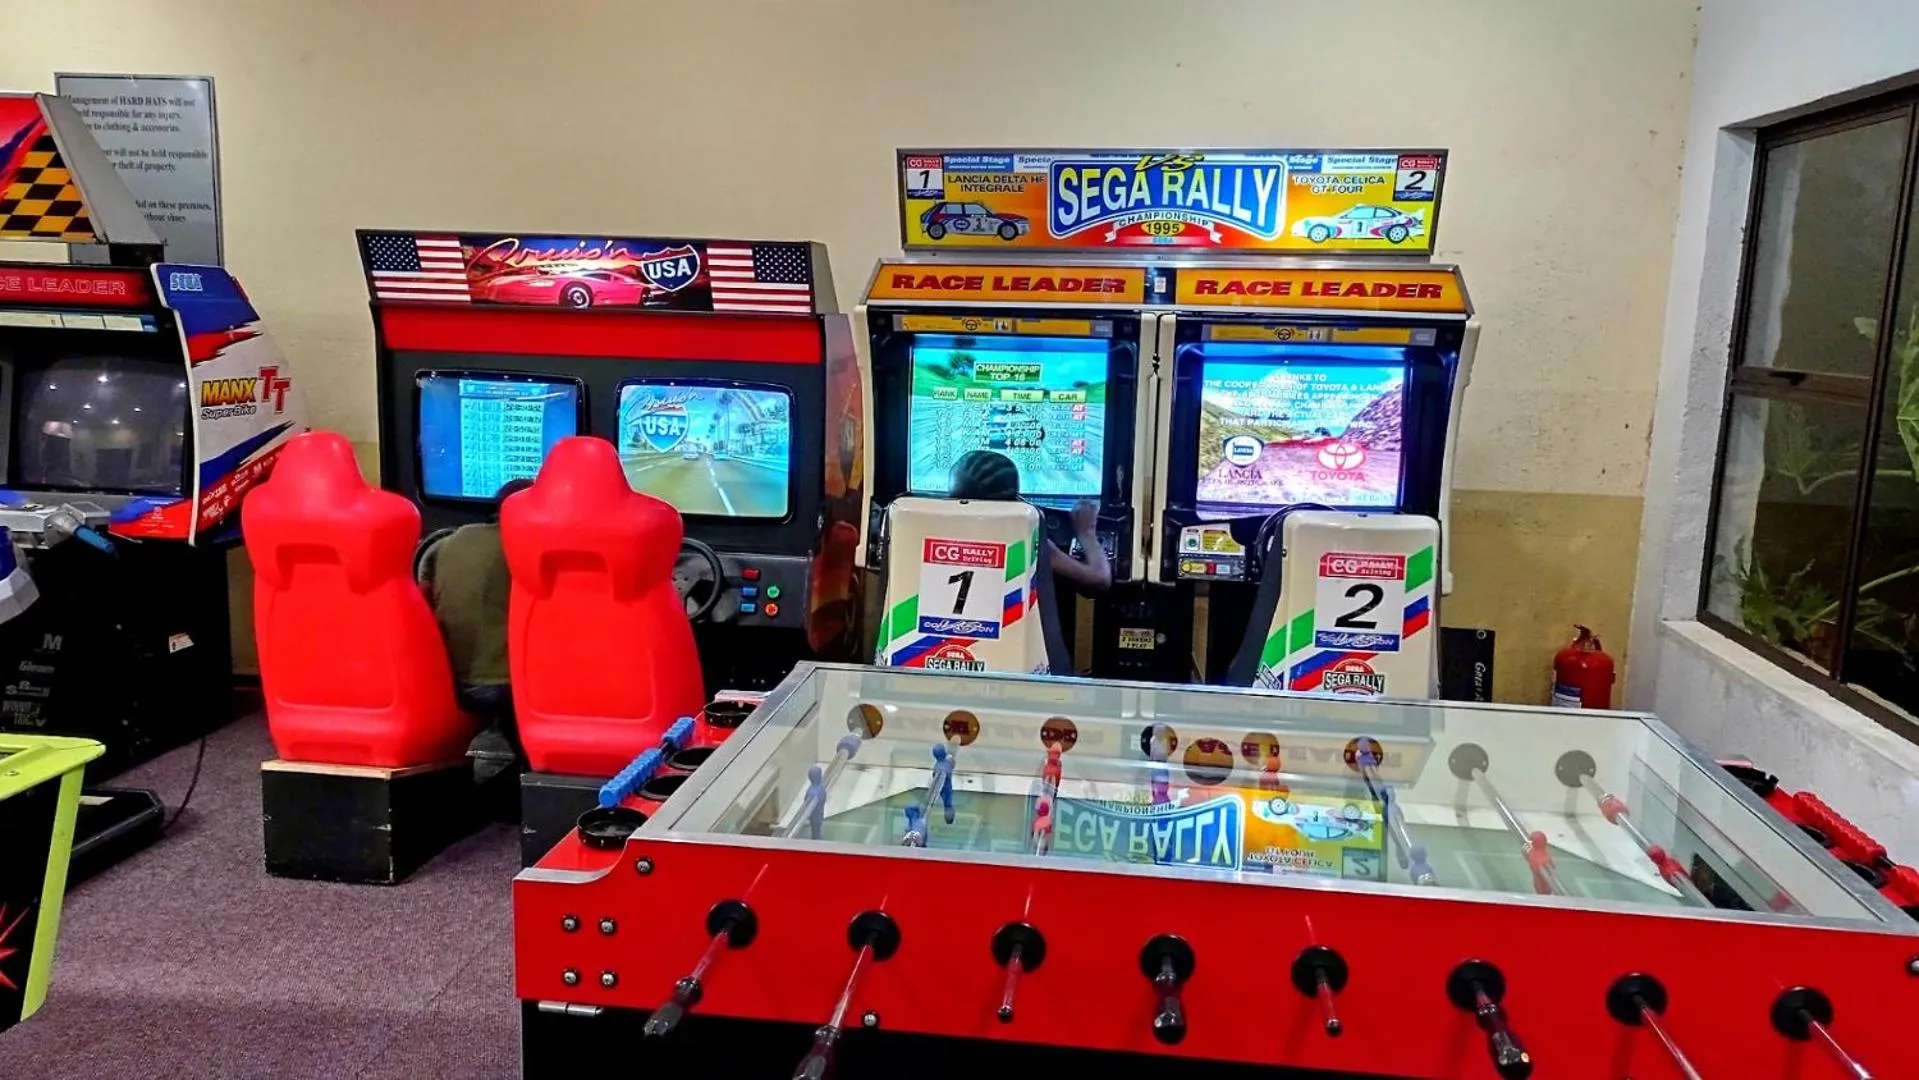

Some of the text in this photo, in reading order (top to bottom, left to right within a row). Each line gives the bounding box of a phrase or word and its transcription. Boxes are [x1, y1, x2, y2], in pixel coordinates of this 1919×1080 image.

[111, 96, 119, 105] of
[119, 95, 144, 105] HARD
[145, 96, 168, 106] HATS
[168, 97, 182, 107] will
[183, 98, 196, 107] not
[132, 109, 142, 118] for
[143, 111, 157, 119] any
[131, 122, 140, 132] &
[113, 147, 127, 157] will
[128, 148, 140, 157] not
[141, 147, 150, 157] be
[151, 147, 167, 158] held
[167, 148, 208, 160] responsible
[943, 155, 980, 165] Special
[982, 155, 1010, 165] Stage
[1328, 155, 1365, 165] Special
[136, 160, 144, 169] of
[919, 169, 931, 189] 1
[947, 175, 991, 184] LANCIA
[993, 175, 1028, 184] DELTA
[1294, 175, 1385, 185] TOYOTA CELICA
[1404, 170, 1427, 190] 2
[960, 184, 1025, 193] INTEGRALE
[1311, 185, 1364, 194] GT-FOUR
[1057, 166, 1277, 228] SEGA RALLY
[1118, 211, 1210, 227] CHAMPIONSHIP
[1145, 222, 1181, 235] 1995
[648, 257, 693, 279] USA
[27, 277, 126, 295] LEADER
[169, 272, 204, 291] SEGA
[891, 273, 1127, 294] RACE LEADER
[1195, 279, 1443, 299] RACE LEADER
[975, 363, 1040, 373] CHAMPIONSHIP
[990, 372, 1010, 381] TOP
[1313, 373, 1328, 382] TO
[201, 365, 292, 415] MANX TT
[1311, 383, 1348, 391] TOYOTA
[966, 391, 989, 400] NAME
[1012, 392, 1032, 400] TIME
[1057, 393, 1079, 401] CAR
[645, 415, 681, 437] USA
[1218, 469, 1263, 480] LANCIA
[1310, 470, 1366, 482] TOYOTA
[934, 546, 995, 560] CG RALLY
[1330, 559, 1358, 574] CG
[947, 570, 975, 615] 1
[1334, 583, 1384, 629] 2
[926, 658, 985, 672] SEGA RALLY
[1325, 672, 1352, 689] SEGA
[1353, 674, 1385, 692] RALLY
